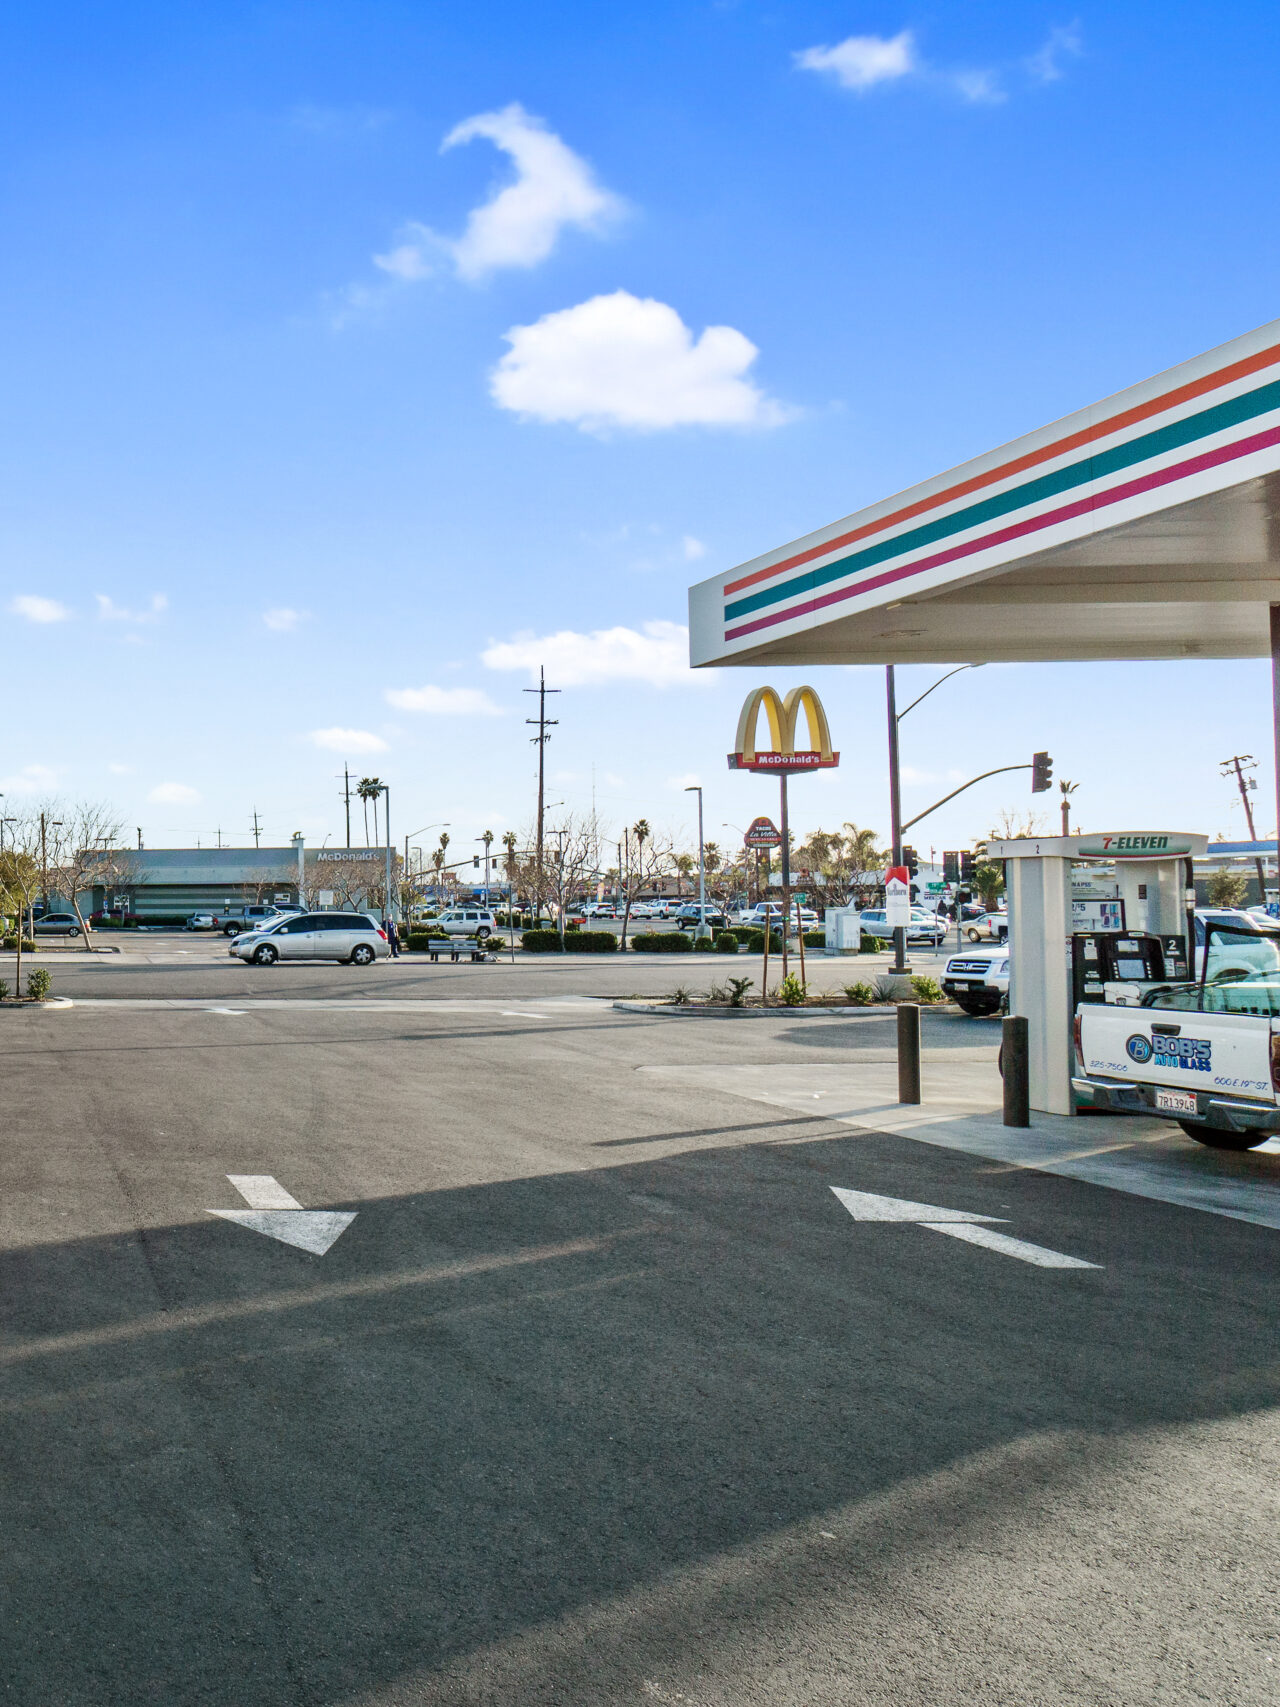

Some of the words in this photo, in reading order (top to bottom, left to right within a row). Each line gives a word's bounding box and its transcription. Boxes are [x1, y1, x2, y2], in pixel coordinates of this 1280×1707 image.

[758, 755, 820, 764] McDonald's
[1036, 844, 1040, 855] 2
[317, 851, 380, 861] McDonald's
[1168, 939, 1177, 950] 2
[1151, 1034, 1212, 1060] BOB'S
[1154, 1054, 1178, 1068] AUTO
[1179, 1057, 1212, 1072] GLASS
[1214, 1076, 1232, 1086] 600
[1158, 1095, 1196, 1112] 7R13948
